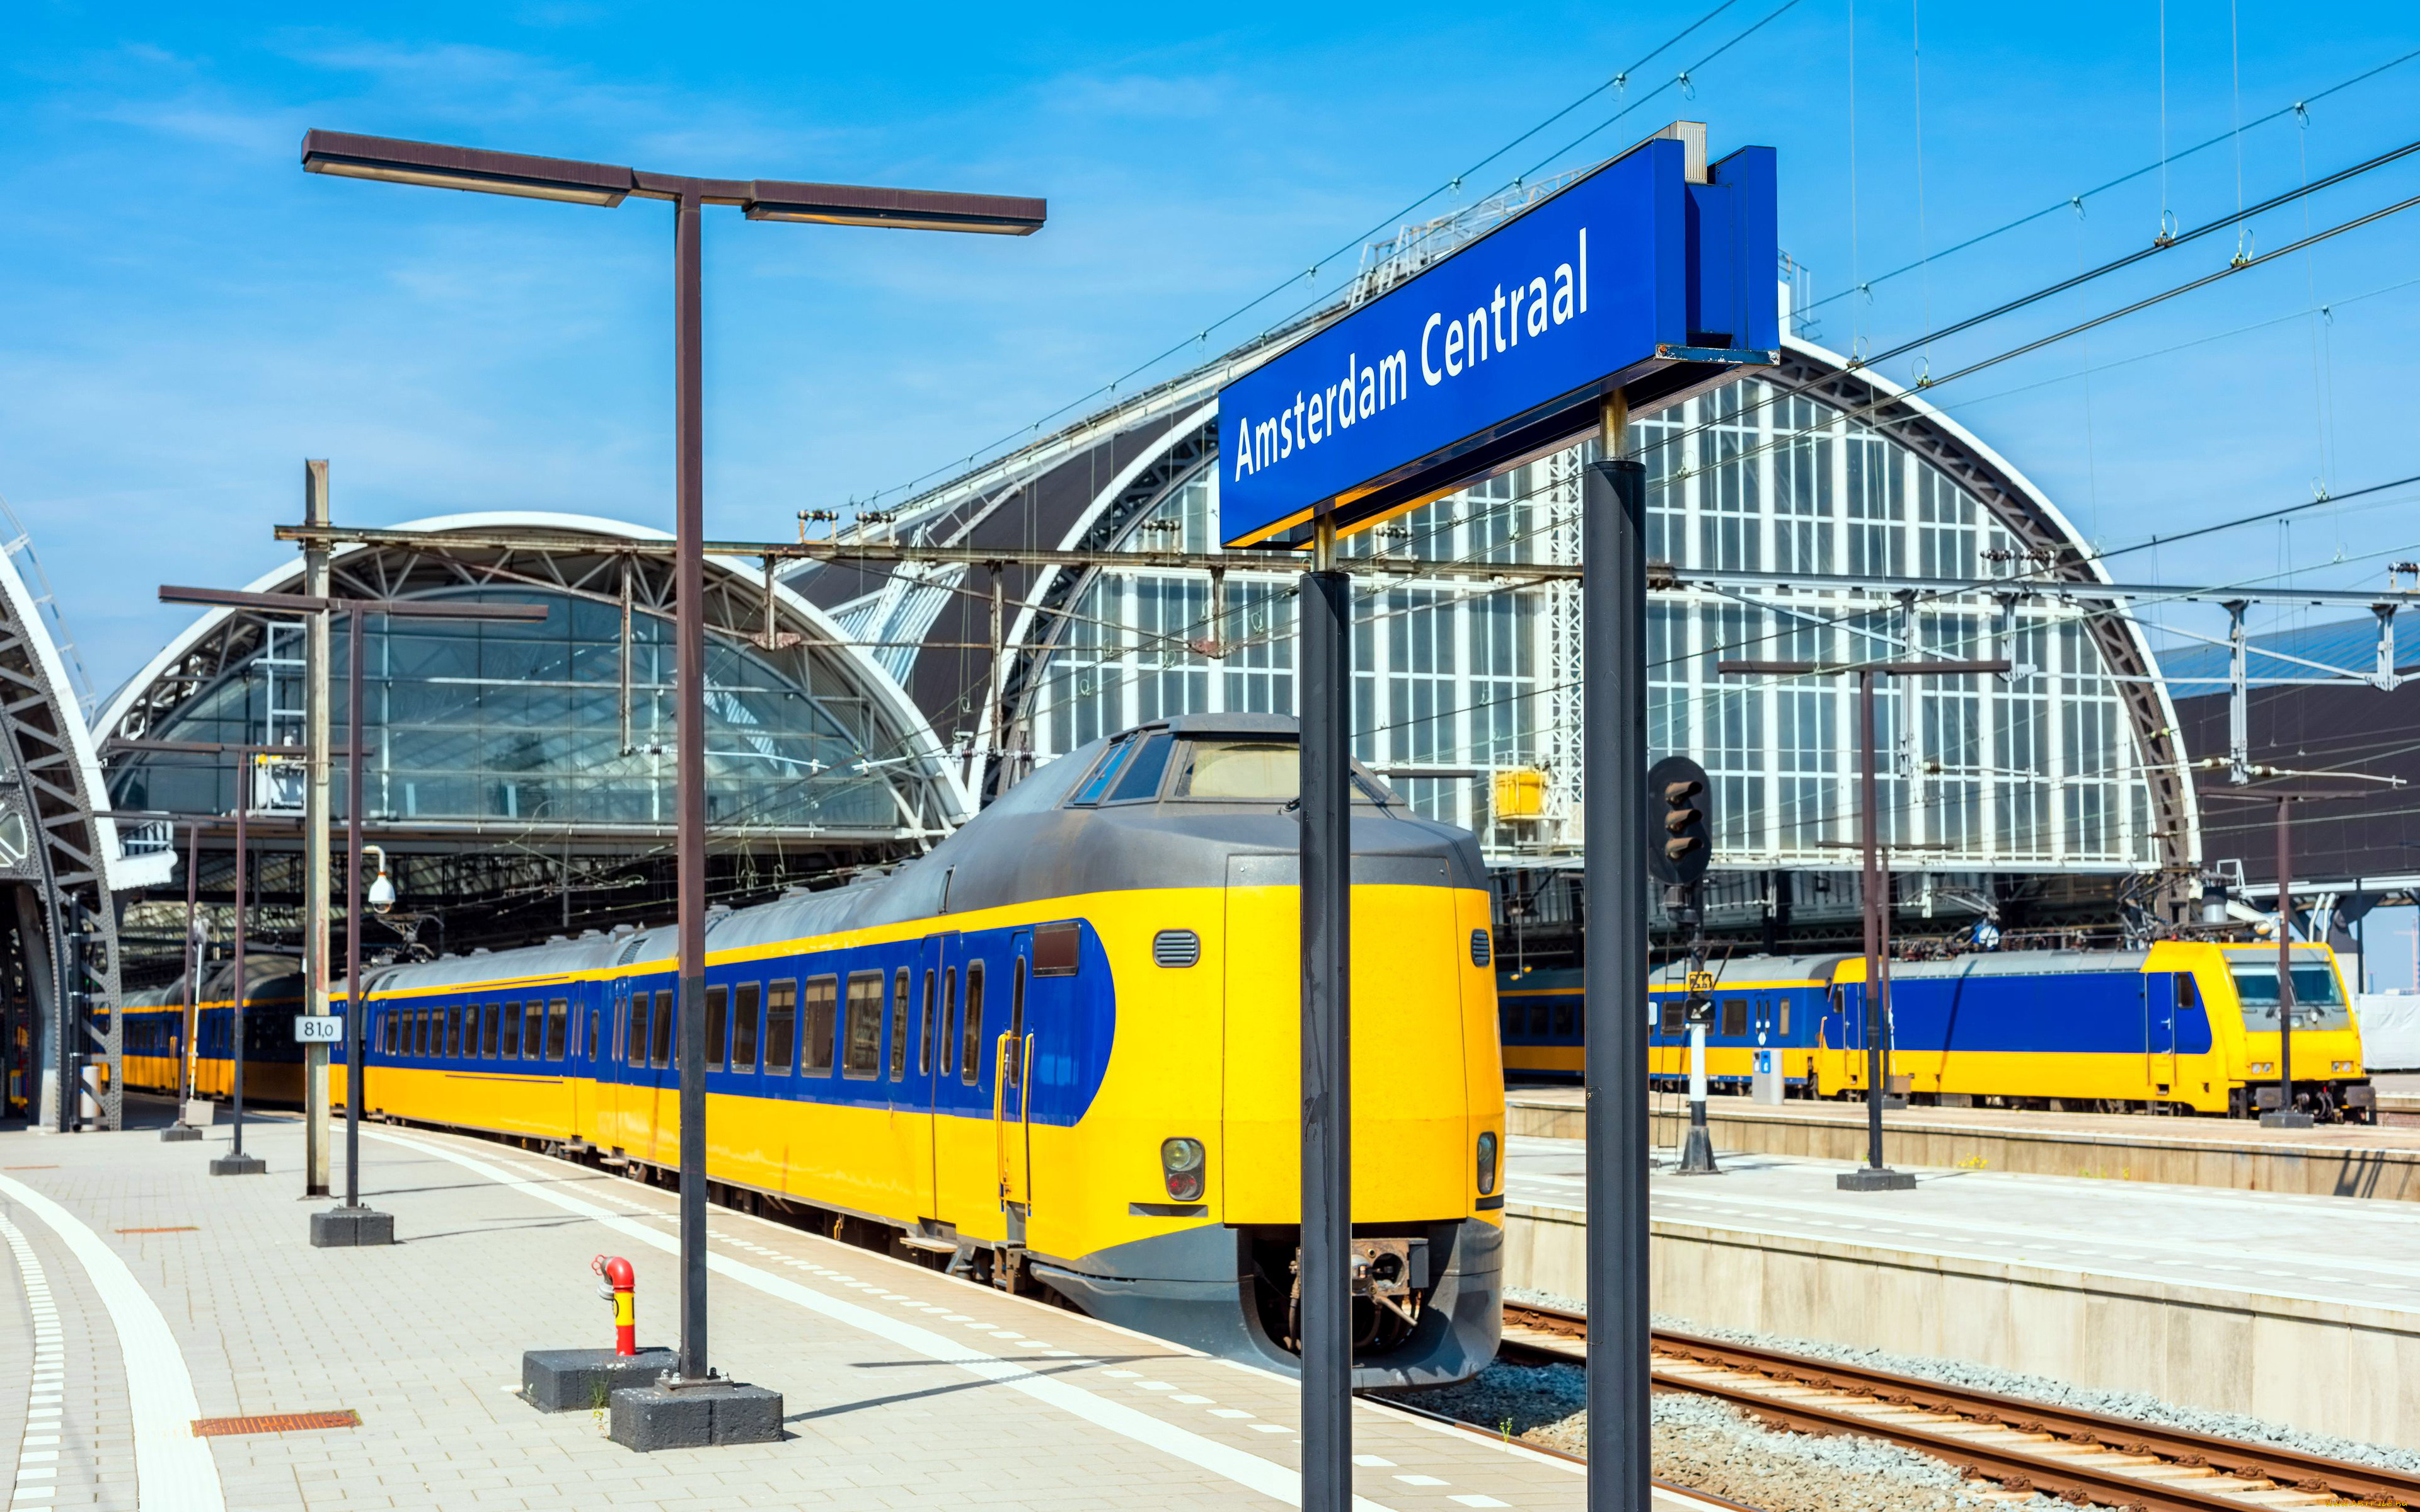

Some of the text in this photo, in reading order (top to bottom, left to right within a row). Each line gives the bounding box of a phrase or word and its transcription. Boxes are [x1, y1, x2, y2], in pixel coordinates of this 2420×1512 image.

[1235, 227, 1587, 483] Amsterdam Centraal
[304, 1021, 333, 1038] 81,0
